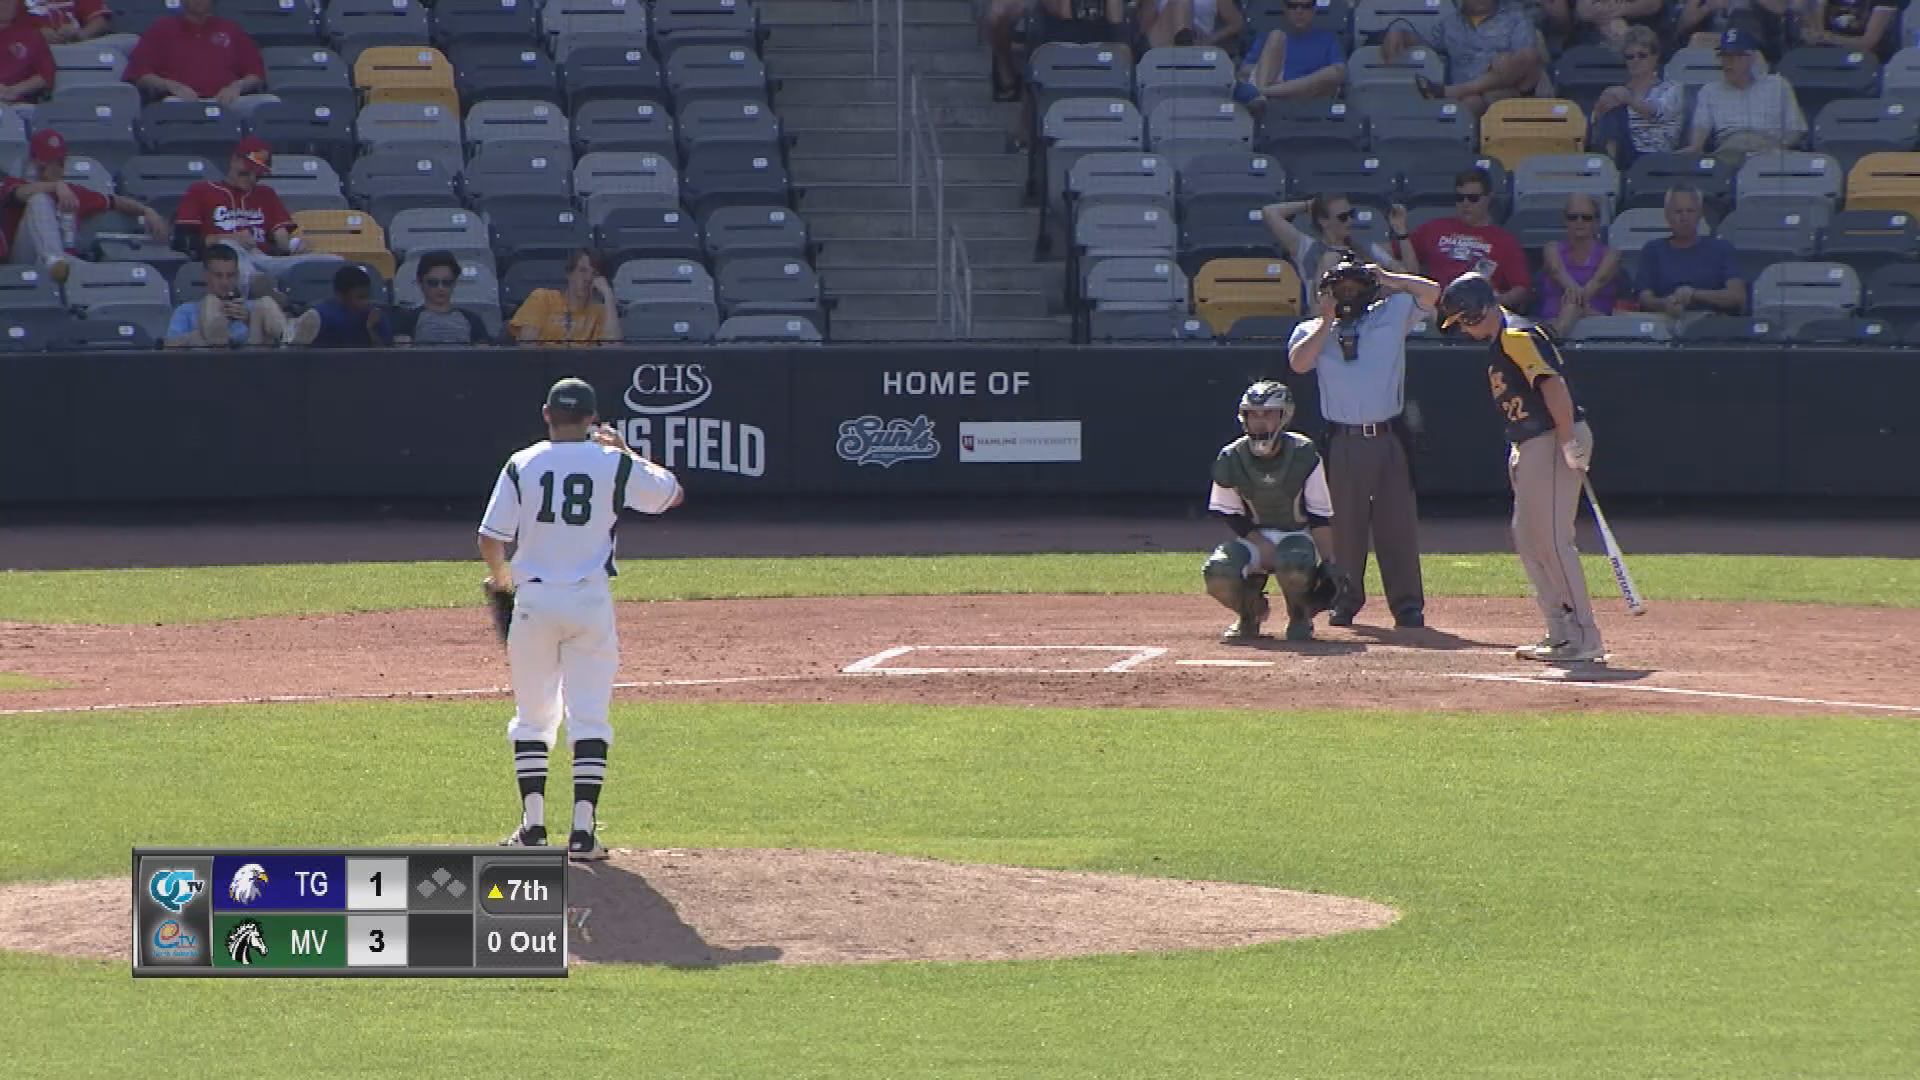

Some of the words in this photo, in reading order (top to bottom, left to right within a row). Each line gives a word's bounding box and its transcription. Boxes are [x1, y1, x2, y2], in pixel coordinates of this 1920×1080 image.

[632, 364, 704, 394] CHS
[883, 371, 976, 395] HOME
[988, 371, 1030, 395] OF
[1502, 396, 1529, 421] 22
[665, 416, 766, 477] FIELD
[536, 471, 593, 526] 18
